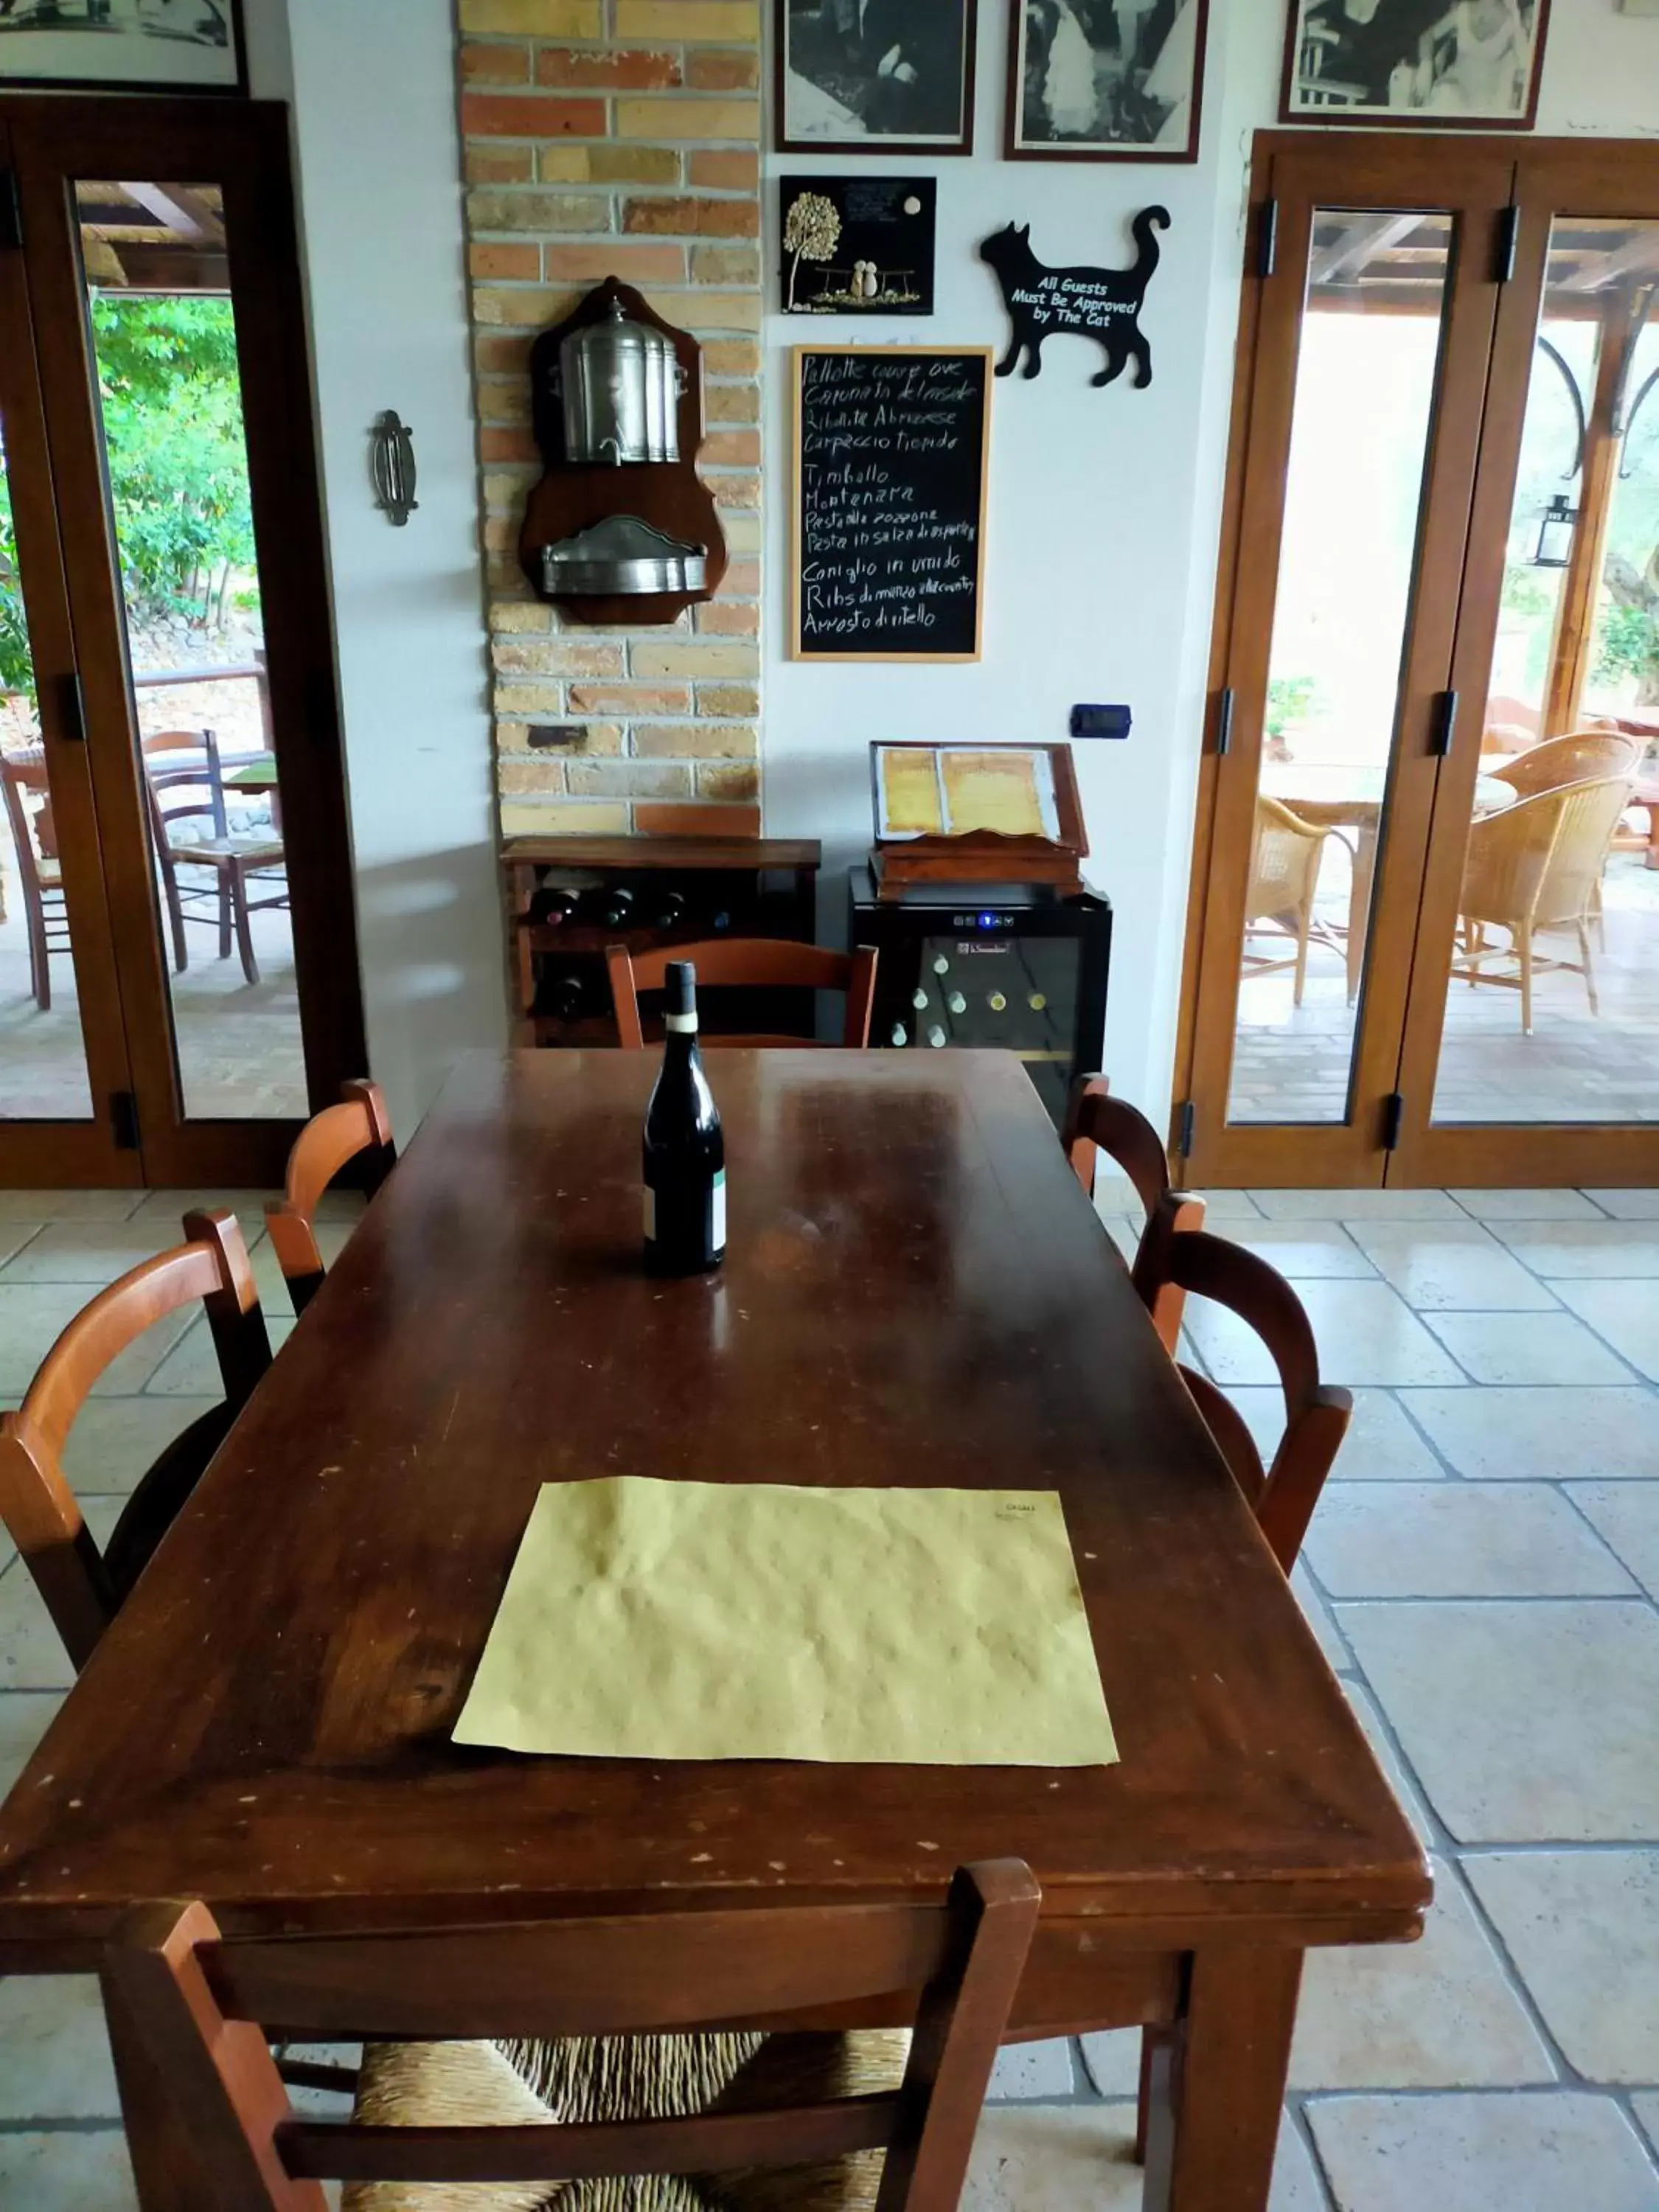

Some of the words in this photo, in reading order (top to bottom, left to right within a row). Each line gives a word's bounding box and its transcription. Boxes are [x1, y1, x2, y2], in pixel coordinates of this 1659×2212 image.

[1037, 276, 1057, 290] All
[1061, 279, 1108, 296] Guests
[1011, 288, 1046, 305] Must
[1051, 293, 1068, 307] Be
[1073, 296, 1137, 315] Approved
[1033, 307, 1051, 324] by
[1057, 309, 1081, 324] The
[1086, 312, 1111, 327] Cat
[804, 432, 890, 457] Carpaccio
[804, 462, 889, 486] Timballo
[807, 532, 848, 554] Pasta
[802, 557, 877, 584] Coniglio
[886, 559, 904, 575] in
[807, 584, 856, 611] Ribs
[803, 609, 871, 634] Arrosto
[874, 605, 888, 627] di
